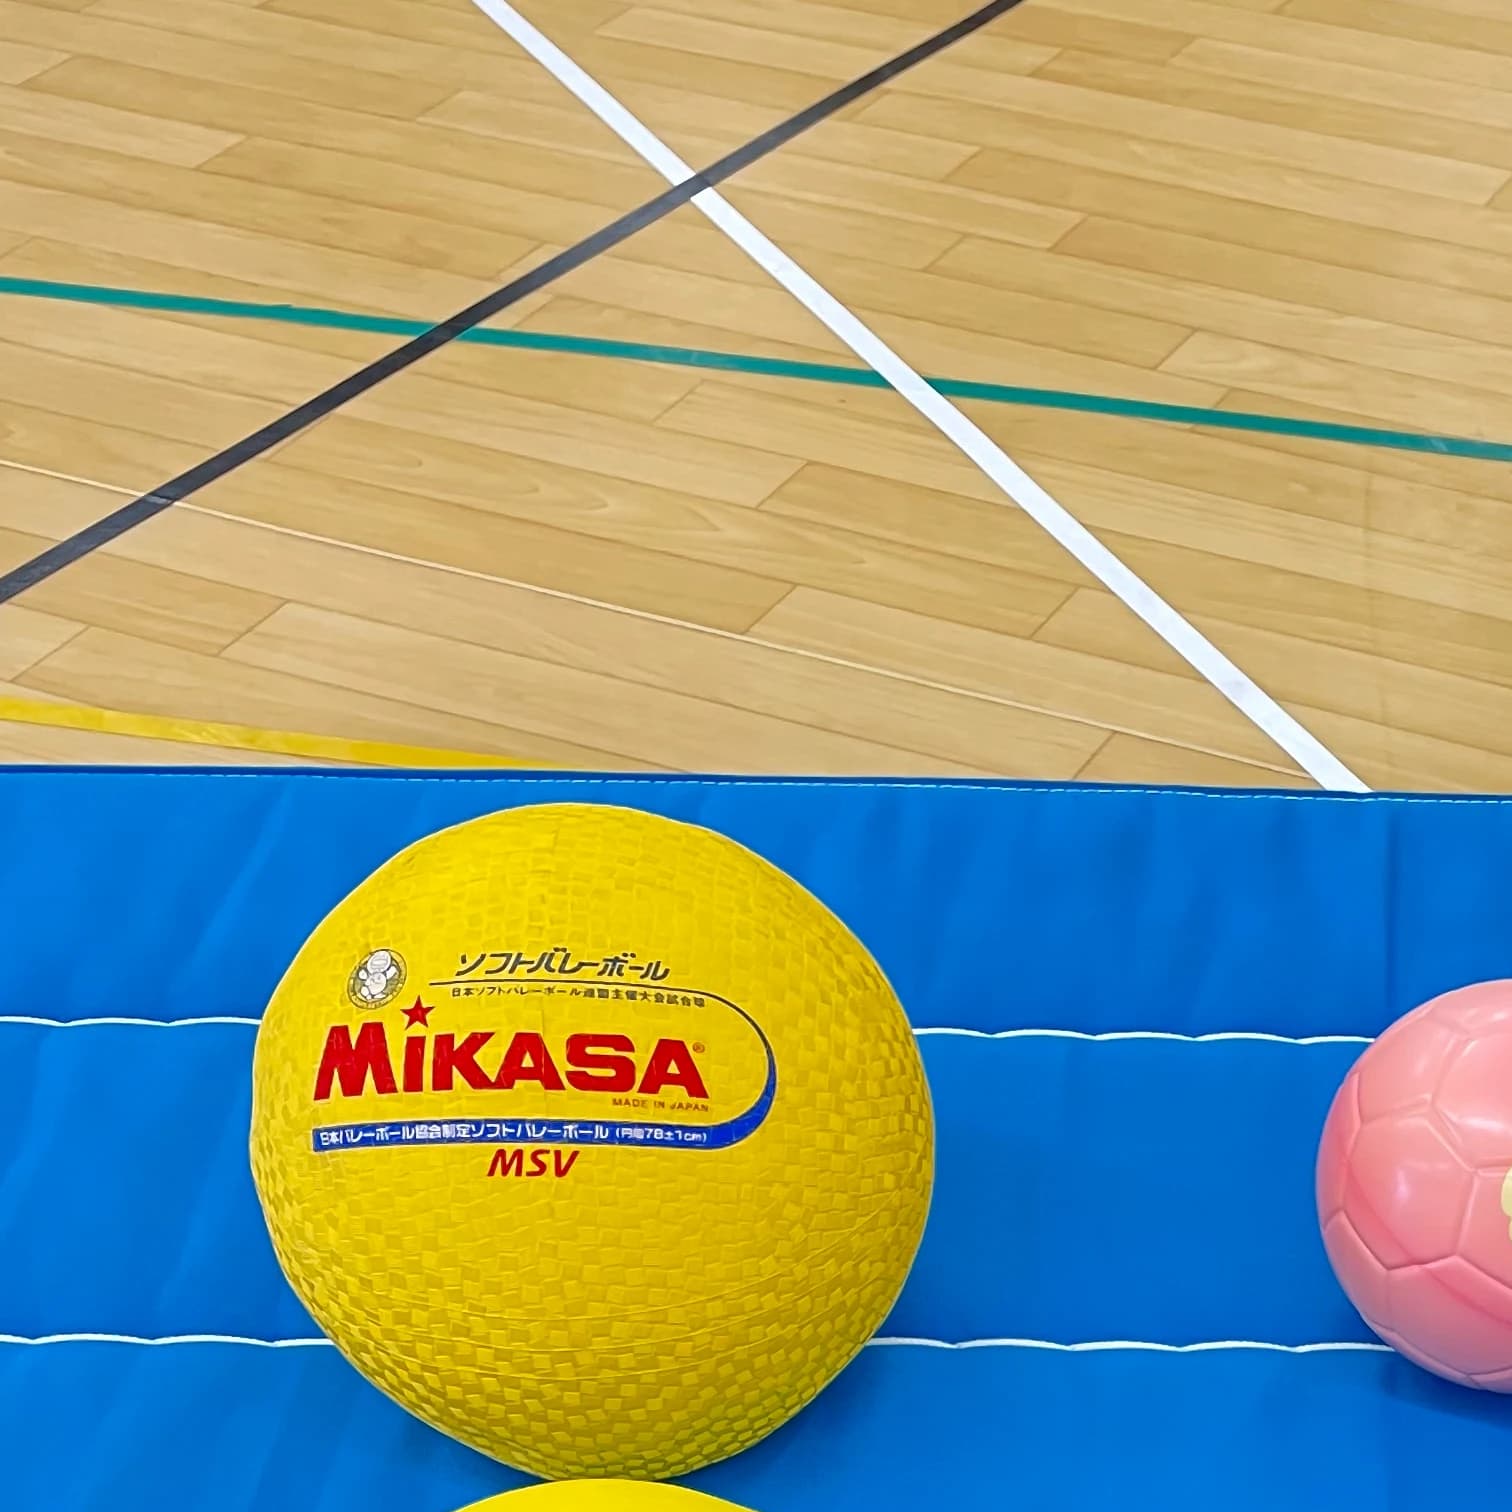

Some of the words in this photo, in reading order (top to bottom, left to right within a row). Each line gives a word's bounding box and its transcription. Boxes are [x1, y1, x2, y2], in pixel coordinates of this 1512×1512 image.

[455, 947, 671, 982] ソフトバレーボール
[611, 1097, 649, 1109] MADE
[653, 1099, 666, 1110] IN
[670, 1100, 710, 1112] JAPAN
[487, 1148, 579, 1178] MSV
